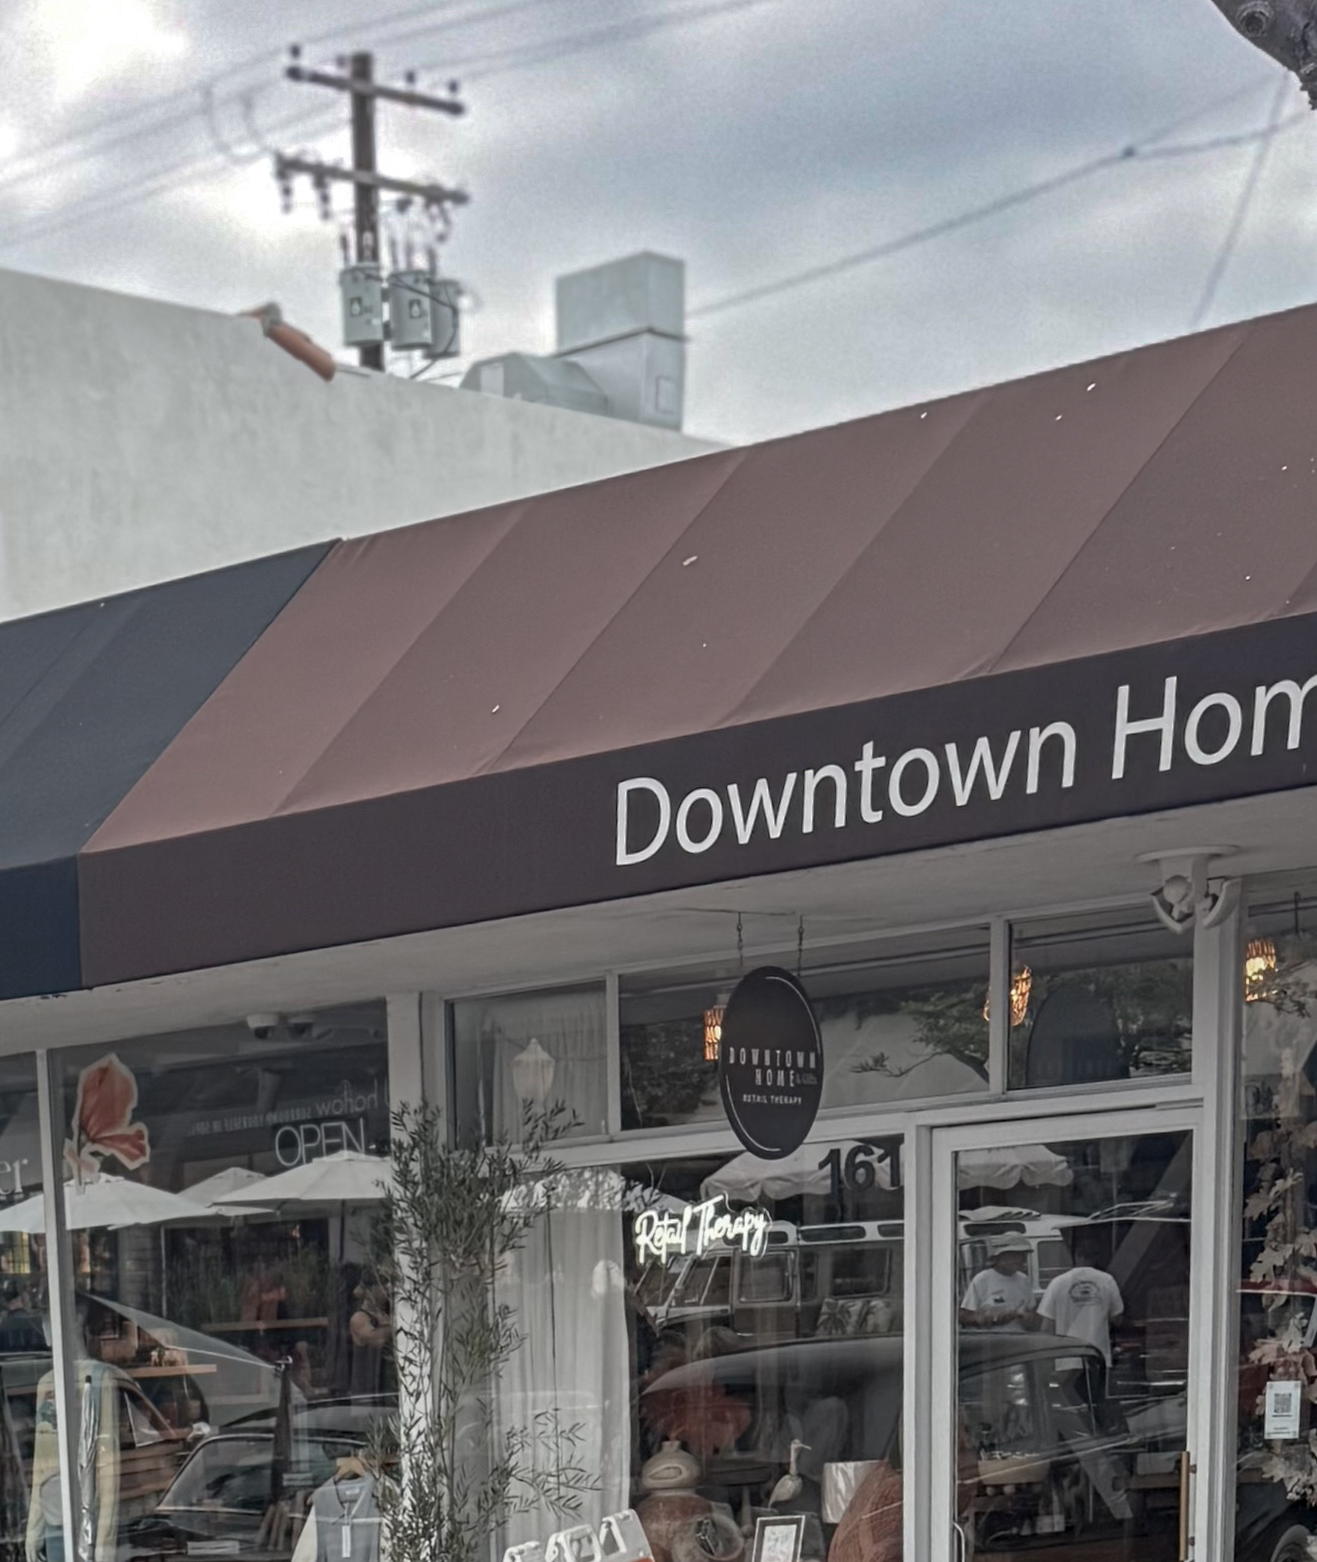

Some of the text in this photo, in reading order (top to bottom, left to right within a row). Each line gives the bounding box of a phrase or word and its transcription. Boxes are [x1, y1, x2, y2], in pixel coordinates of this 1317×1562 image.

[615, 719, 1077, 867] Downtown
[729, 1046, 816, 1069] DOWNTOWN
[755, 1068, 795, 1087] HOME
[770, 1095, 802, 1105] THERAPY
[818, 1138, 901, 1194] 161
[635, 1194, 768, 1264] Retail Therapy
